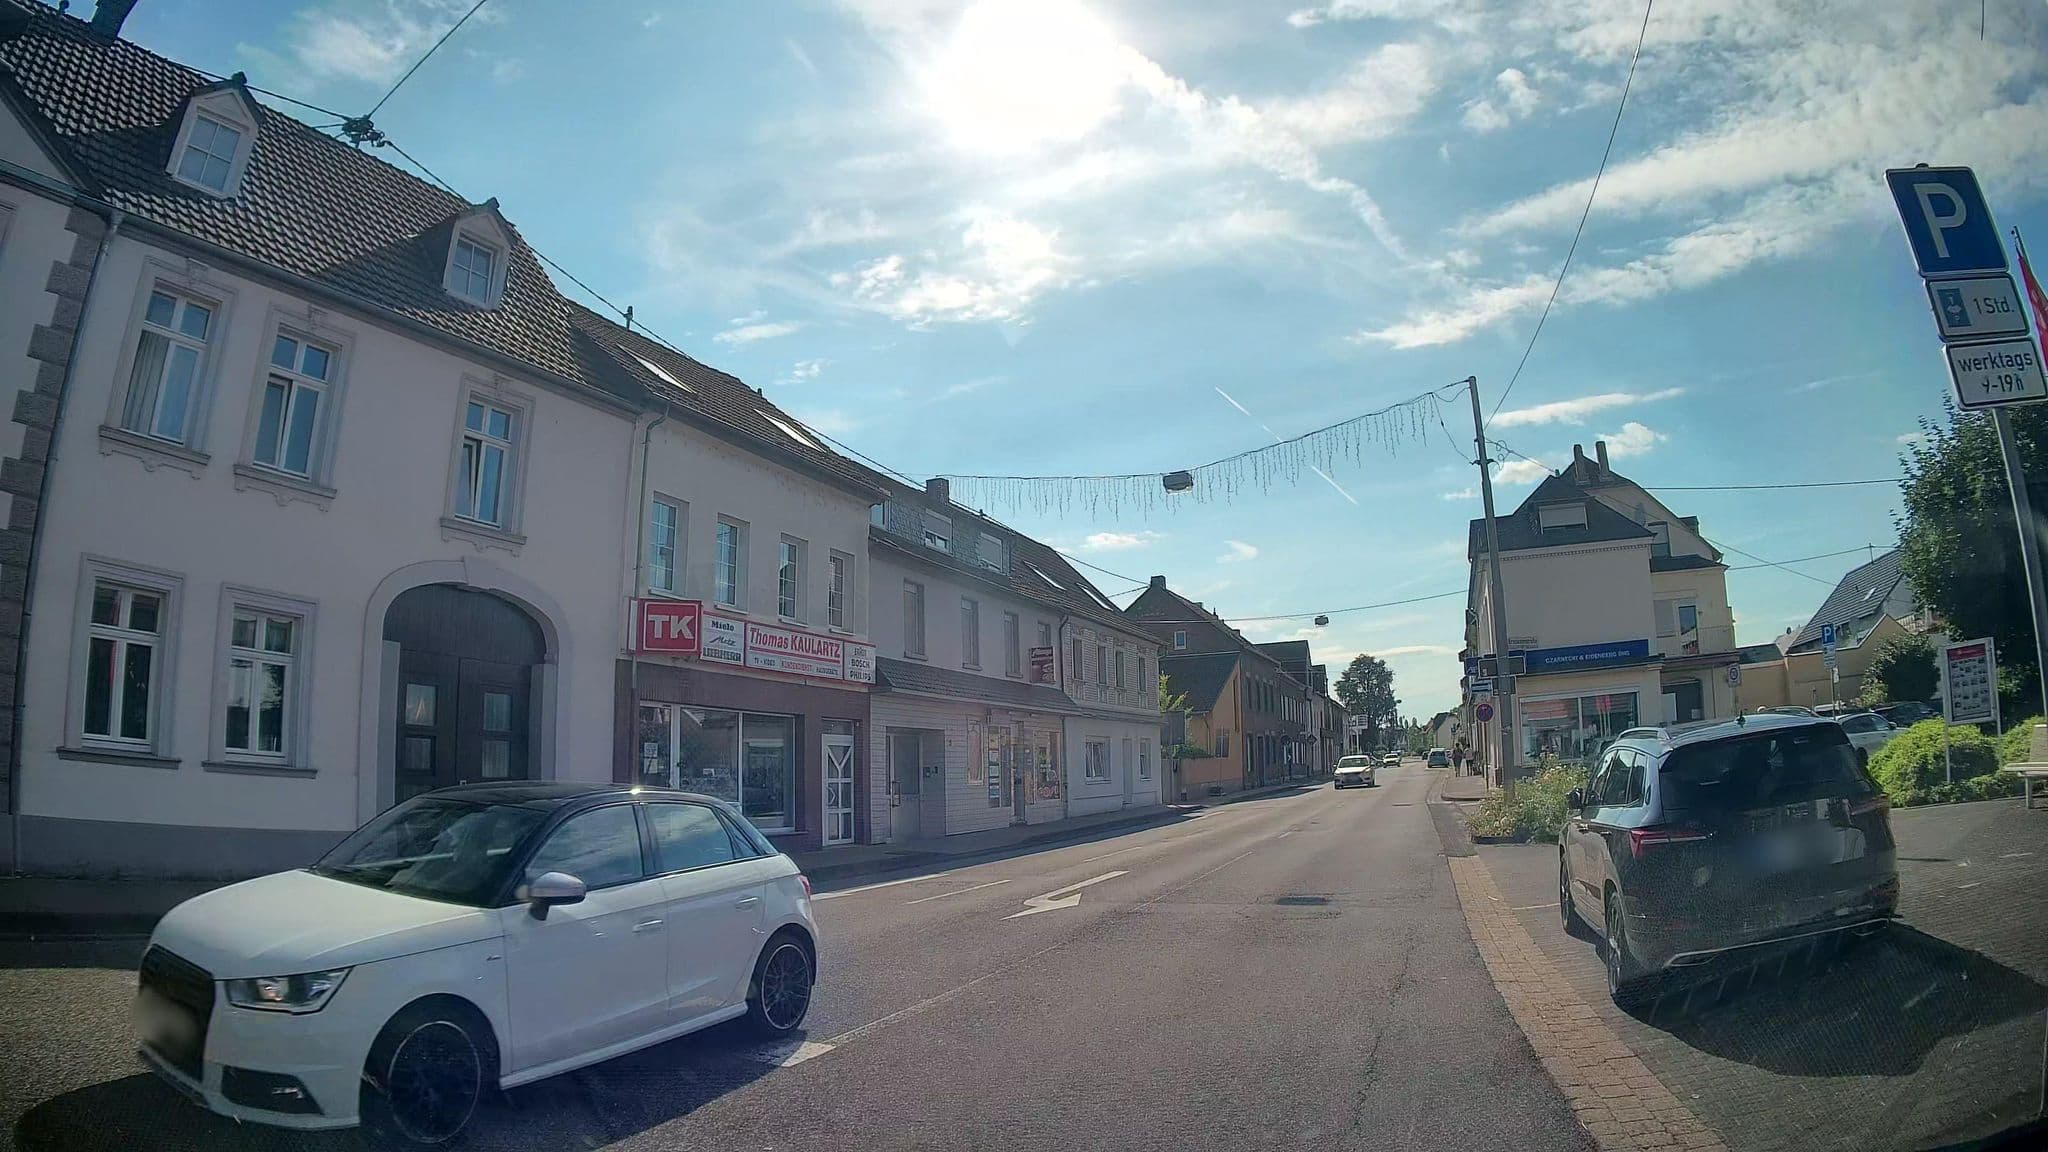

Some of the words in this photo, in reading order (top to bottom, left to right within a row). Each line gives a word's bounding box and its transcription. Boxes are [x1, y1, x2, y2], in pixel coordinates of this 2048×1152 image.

[1912, 182, 1967, 258] P
[1958, 351, 2033, 373] werktags
[648, 615, 695, 639] TK
[1824, 626, 1832, 642] P
[749, 627, 789, 650] Thomas
[790, 634, 841, 658] KAULARTZ
[850, 659, 870, 669] BOSCH
[849, 670, 871, 681] PHILIPS
